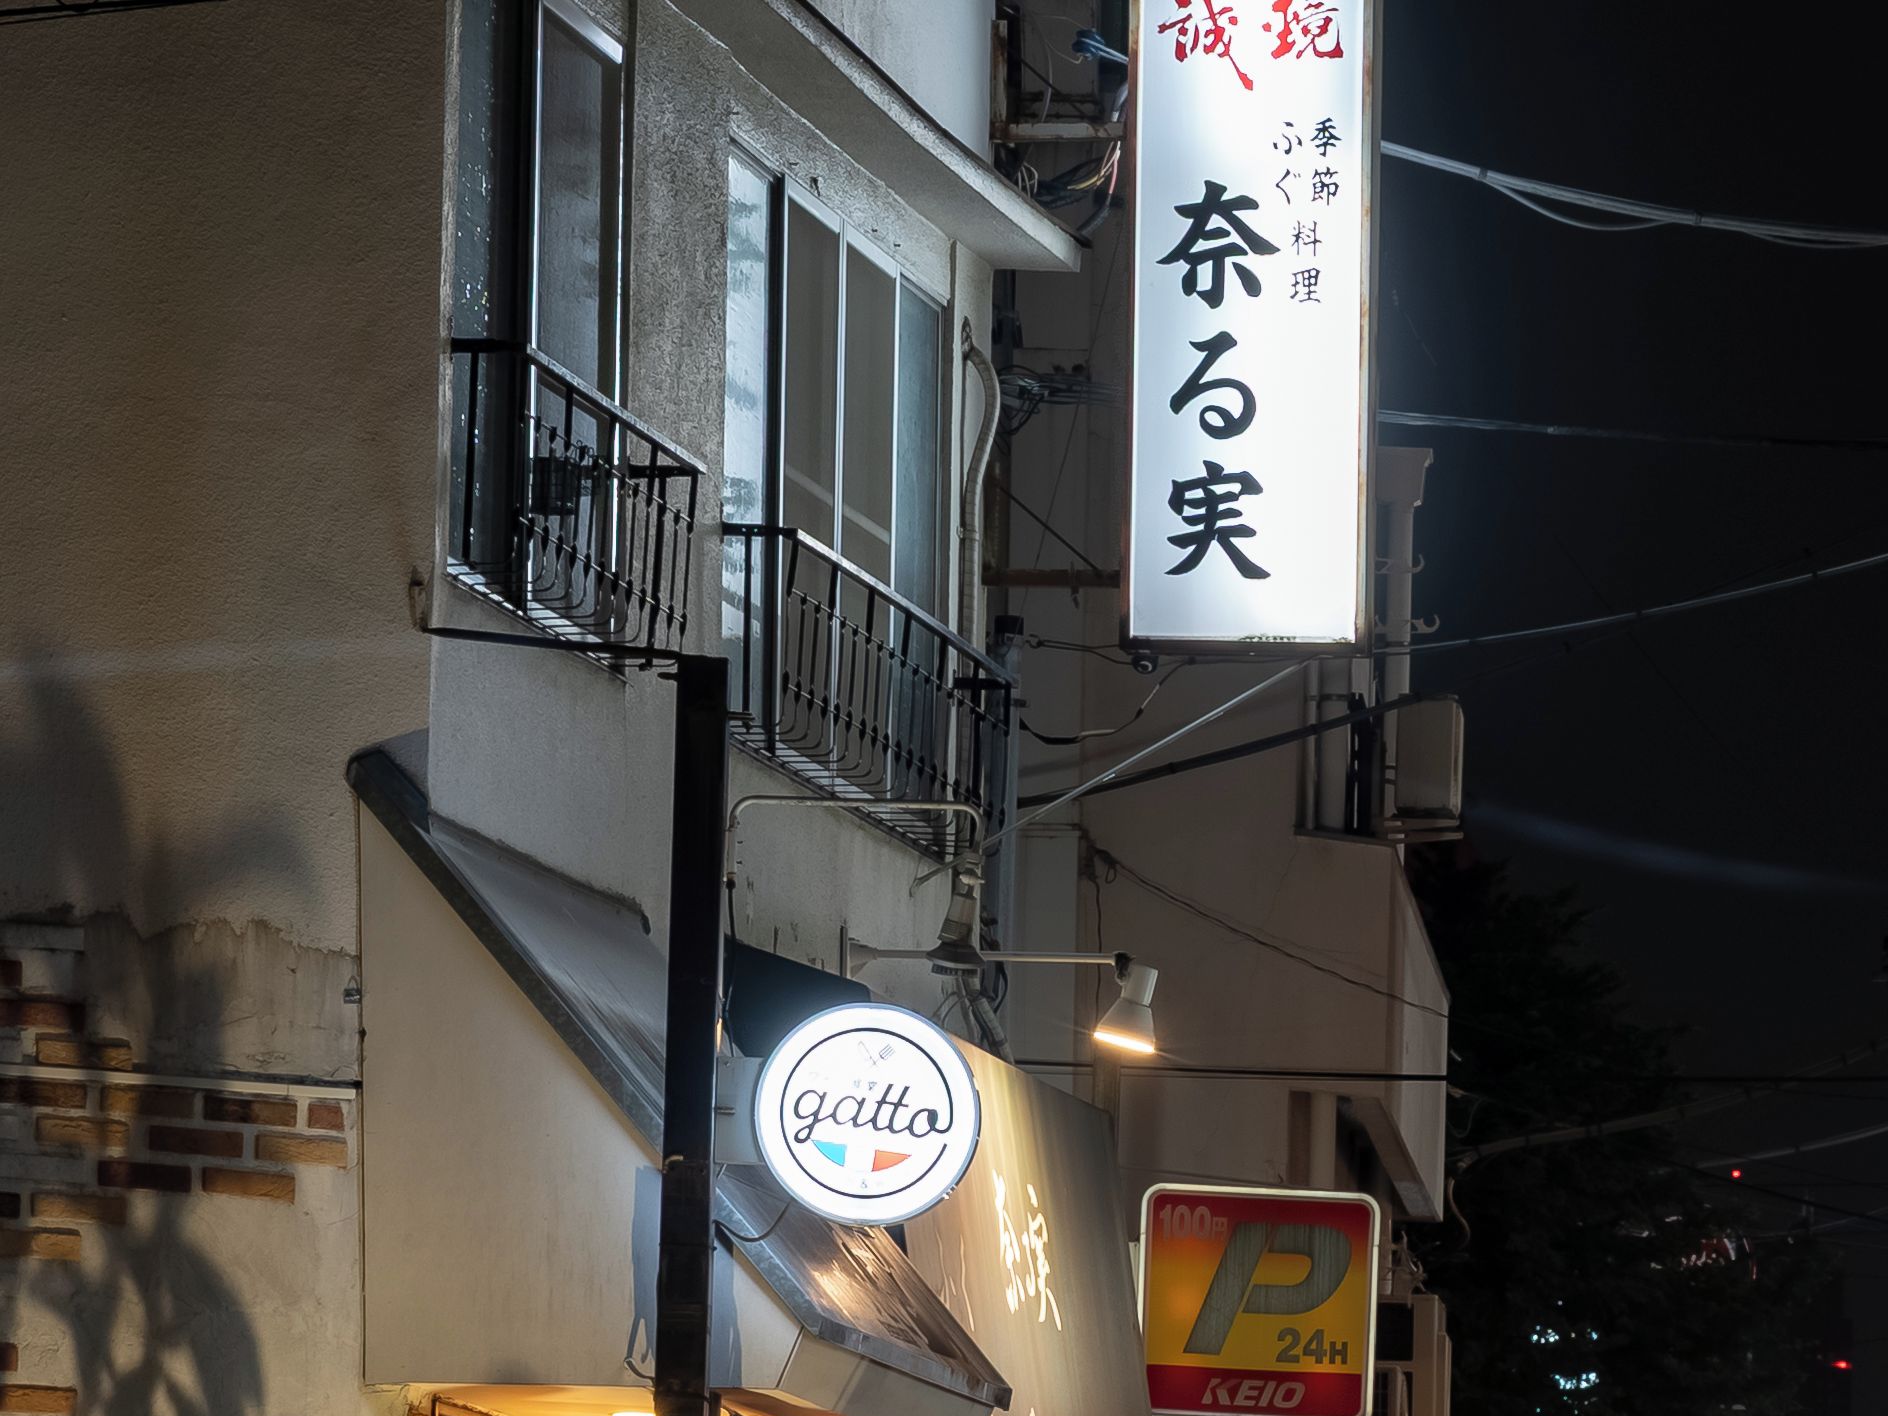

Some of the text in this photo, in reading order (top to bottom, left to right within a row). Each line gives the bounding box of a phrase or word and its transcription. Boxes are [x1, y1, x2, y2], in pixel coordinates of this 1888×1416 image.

[1272, 121, 1302, 205] ふぐ
[1310, 117, 1342, 207] 季節
[1290, 220, 1322, 304] 料理
[1155, 180, 1281, 580] 奈る実
[794, 1084, 940, 1144] gatto
[1158, 1203, 1229, 1242] 100円
[1275, 1327, 1349, 1366] 24H
[1201, 1376, 1306, 1410] KEIO
